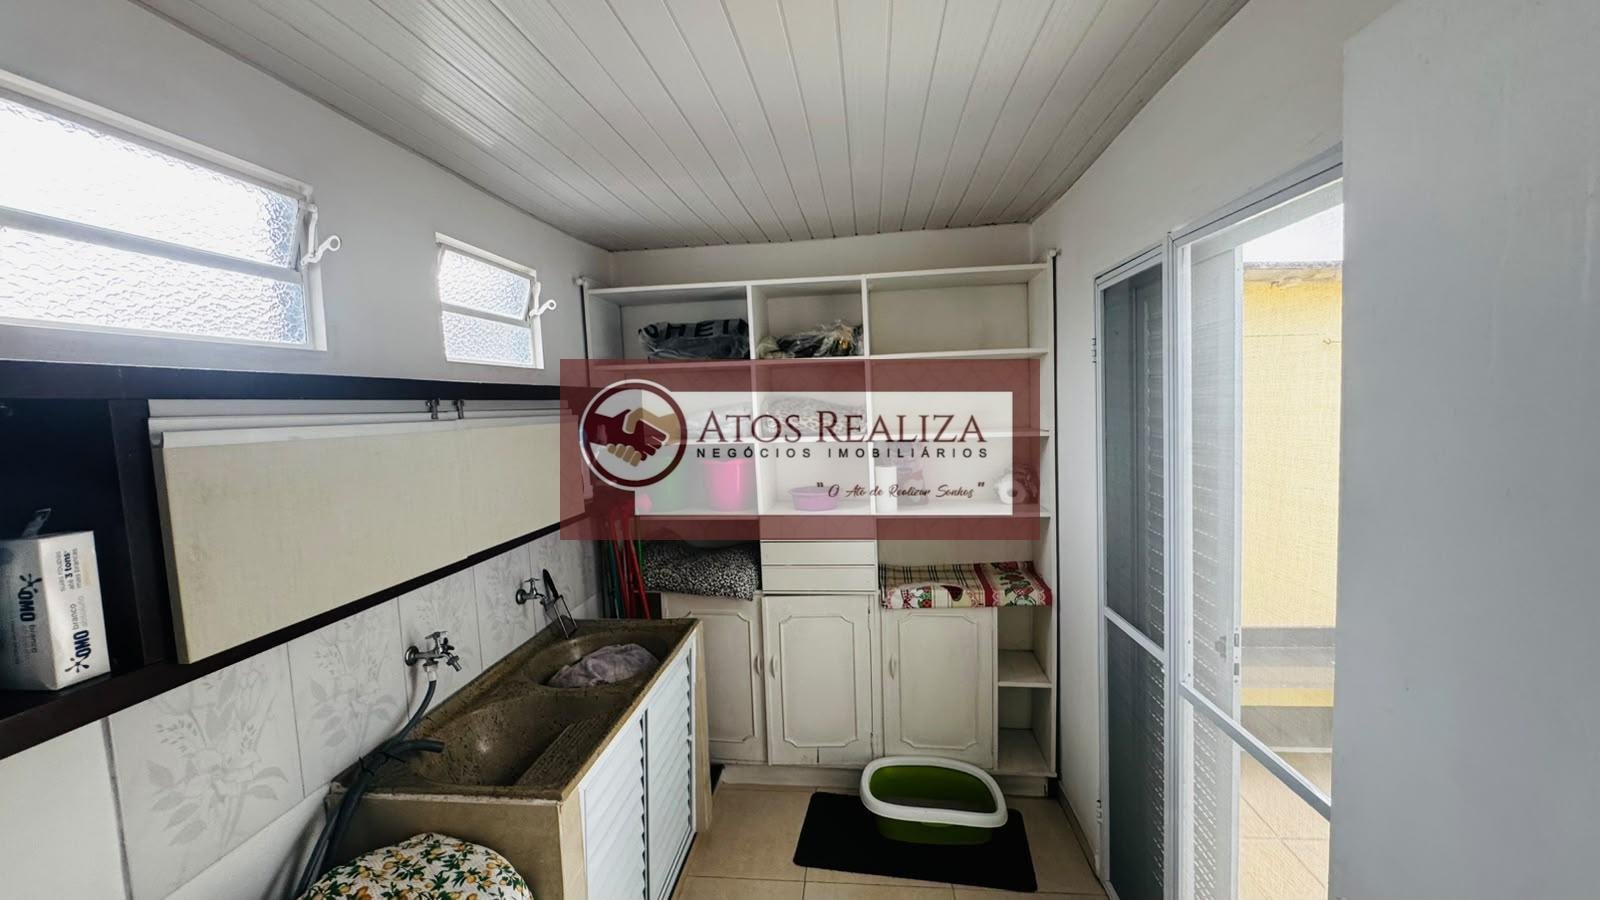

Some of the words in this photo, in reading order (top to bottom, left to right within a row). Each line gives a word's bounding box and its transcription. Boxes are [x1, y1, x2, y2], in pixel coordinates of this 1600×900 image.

[18, 591, 35, 621] OMO
[71, 604, 79, 630] branco
[73, 630, 91, 657] OMO
